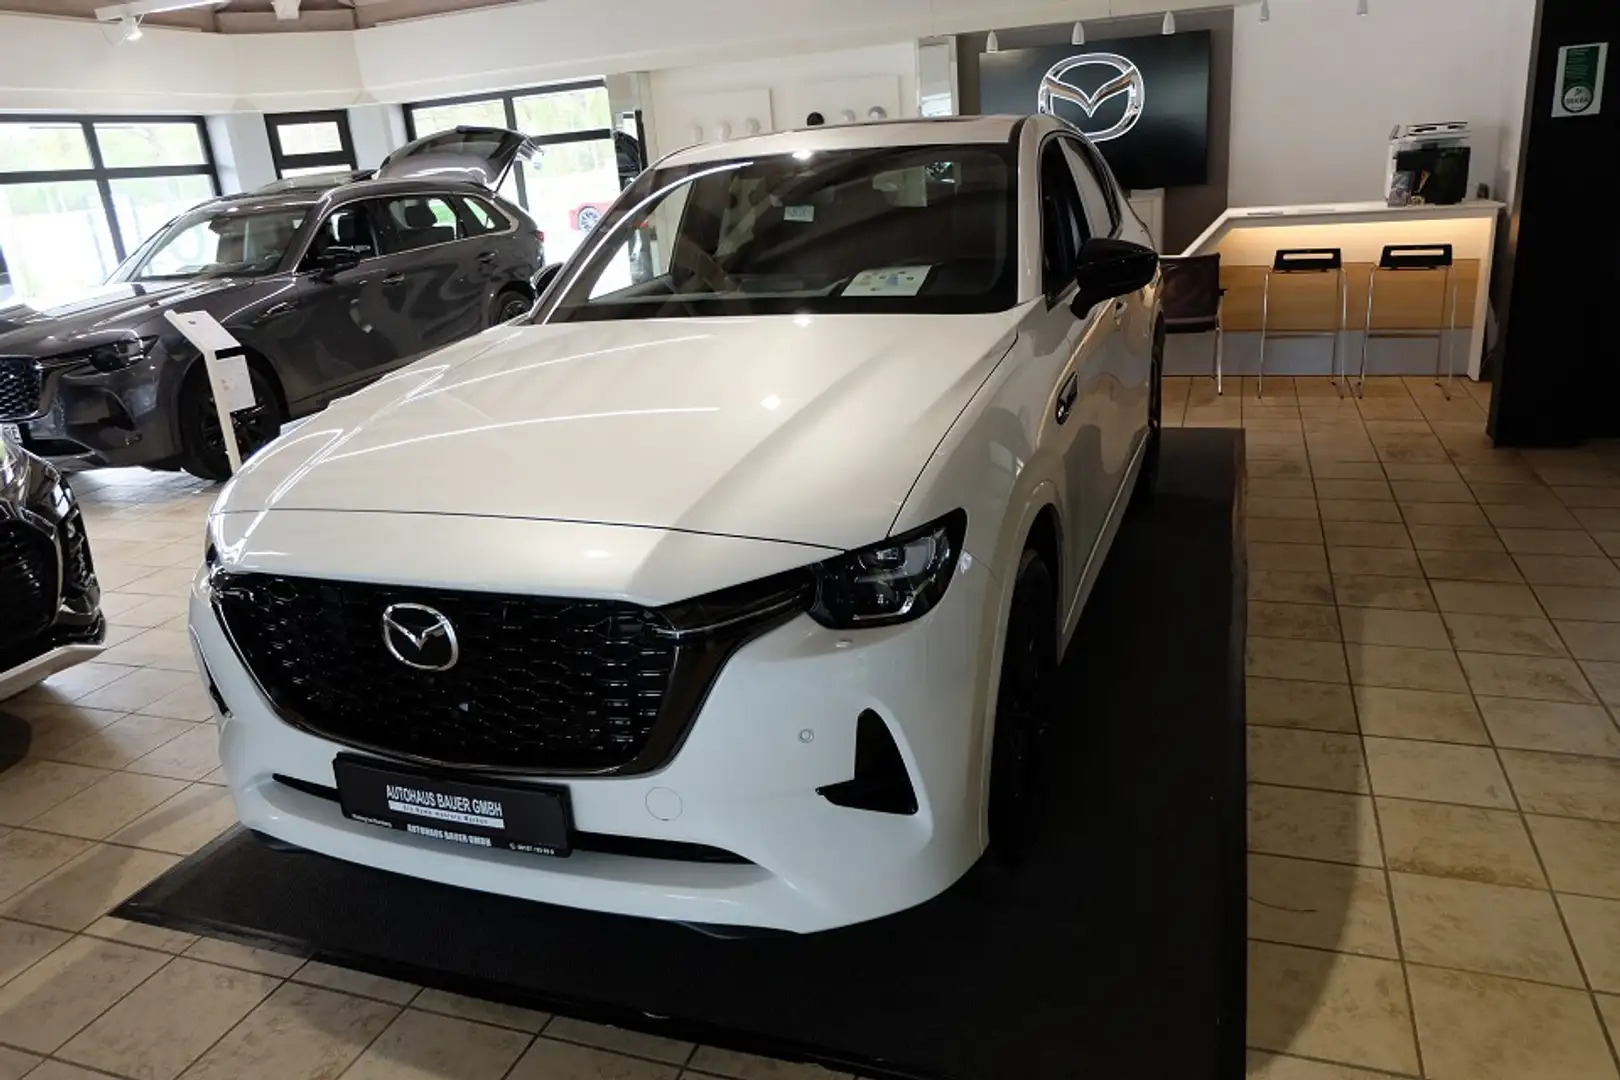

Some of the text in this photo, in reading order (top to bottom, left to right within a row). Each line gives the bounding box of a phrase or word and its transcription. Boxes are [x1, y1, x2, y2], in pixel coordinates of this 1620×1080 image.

[386, 784, 503, 817] AUTOHAUS BAUER GMBH
[406, 823, 444, 839] AUTOHAUS
[444, 830, 468, 843] BAUER
